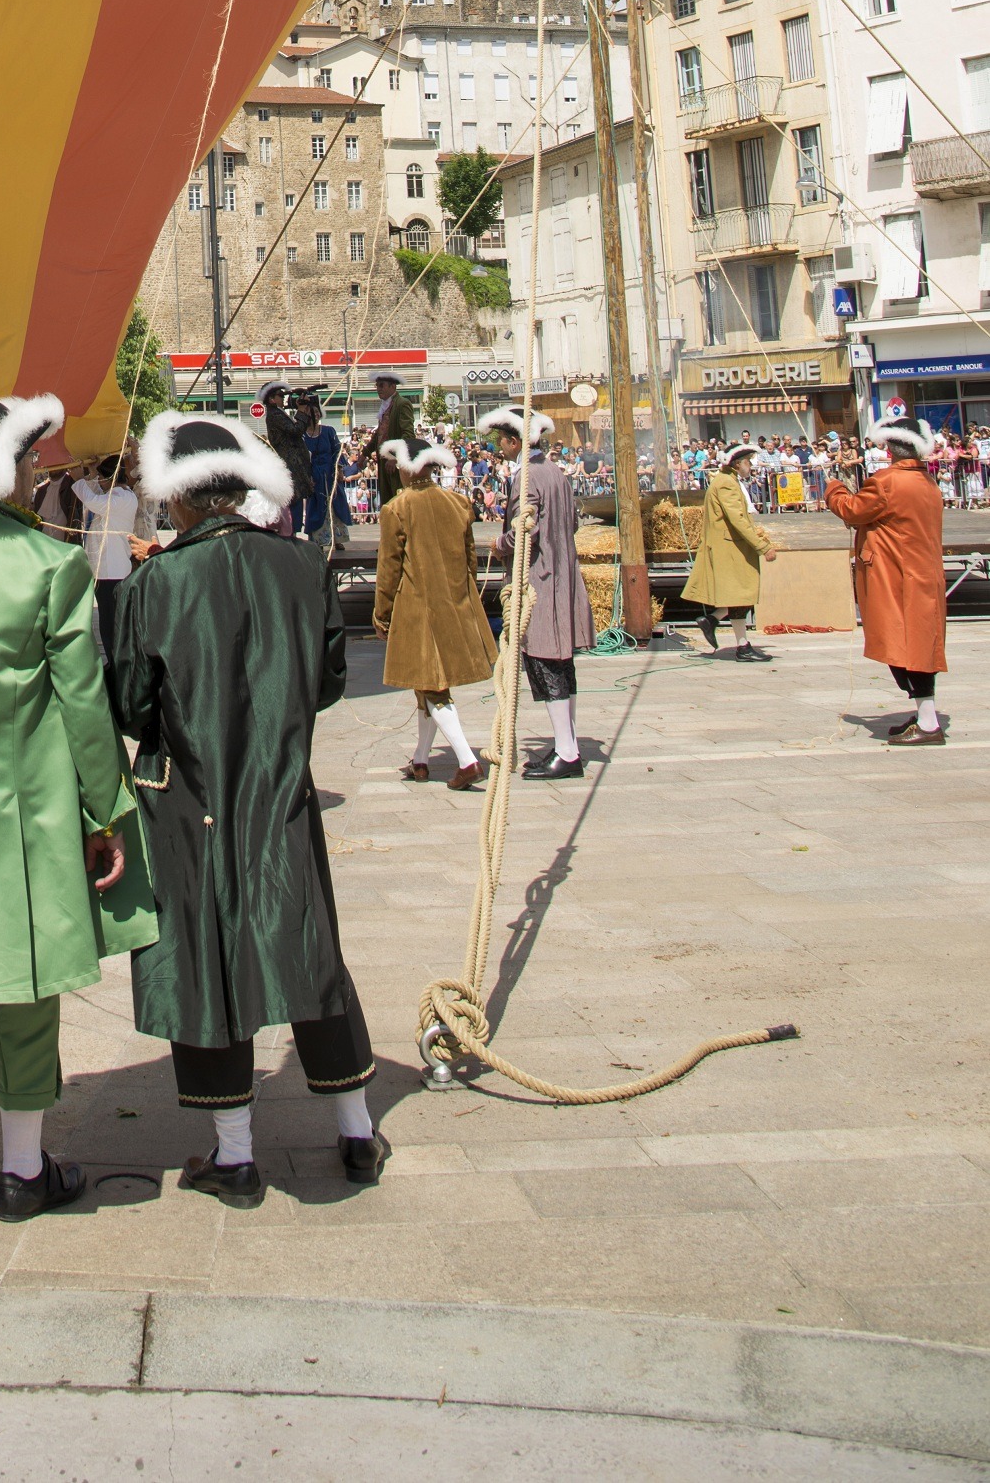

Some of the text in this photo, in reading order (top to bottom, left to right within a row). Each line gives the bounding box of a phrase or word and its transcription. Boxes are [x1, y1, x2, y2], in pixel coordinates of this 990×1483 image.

[836, 301, 853, 312] AXA
[251, 354, 300, 364] SPAR
[918, 365, 953, 373] PLACEMENT
[956, 363, 983, 371] BANQUE
[702, 361, 821, 387] DROGUERIE
